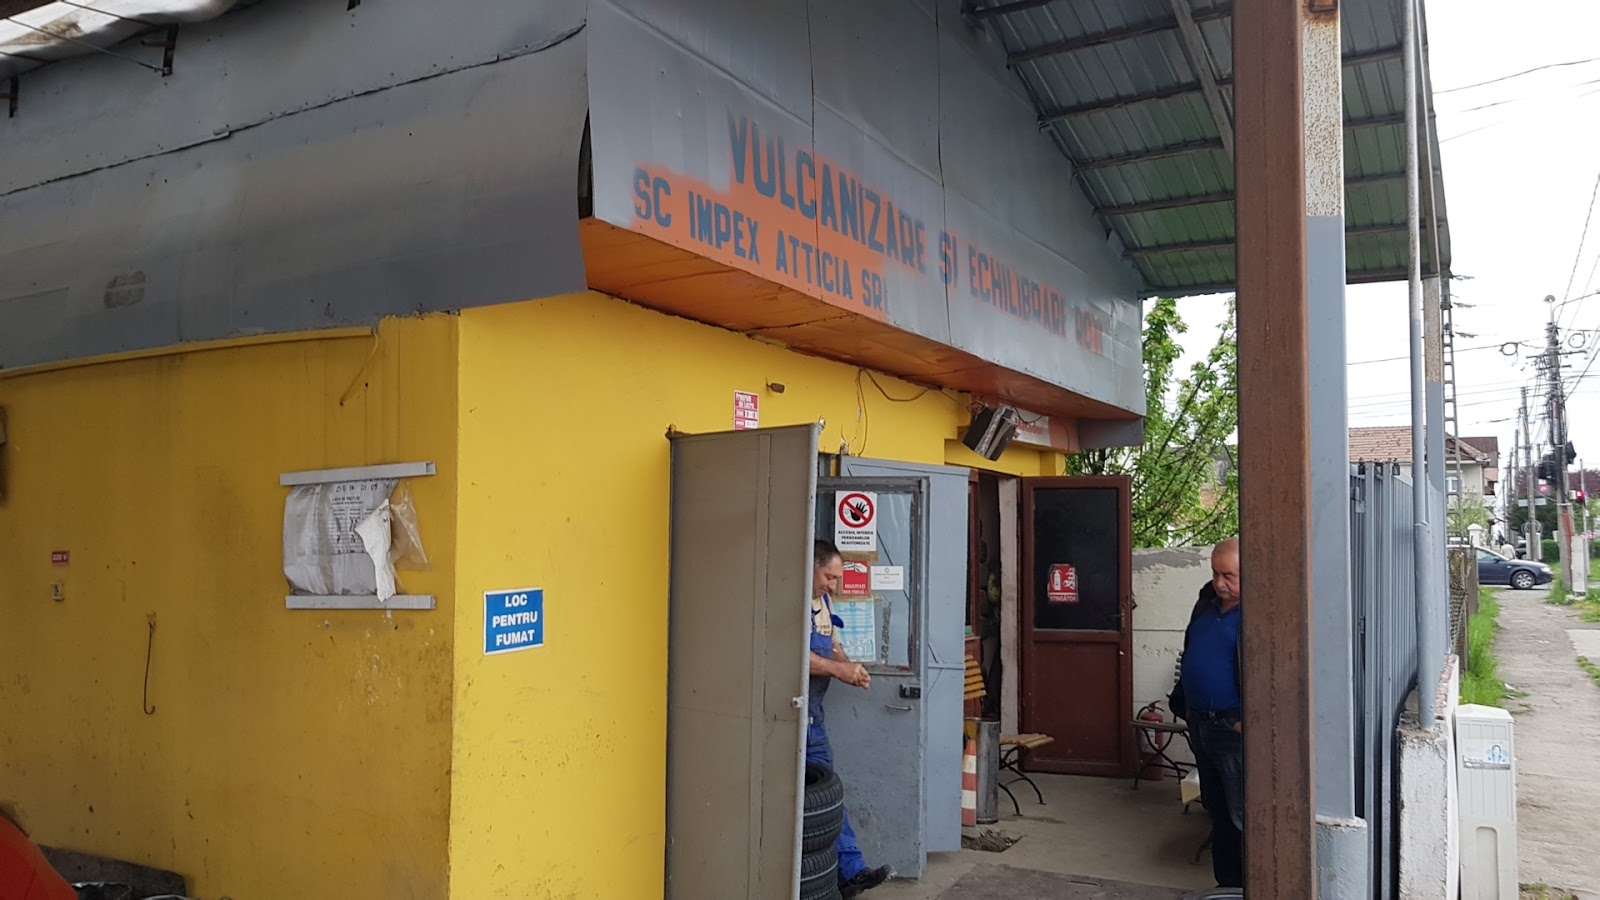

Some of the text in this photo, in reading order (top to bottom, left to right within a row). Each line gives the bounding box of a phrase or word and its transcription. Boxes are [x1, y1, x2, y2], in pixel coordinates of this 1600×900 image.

[727, 107, 927, 275] VULCANIZARE
[938, 230, 958, 288] SI
[633, 168, 671, 228] SC
[688, 190, 760, 265] IMPEX
[776, 230, 853, 300] ATTICIA
[504, 593, 528, 608] LOC
[492, 611, 538, 628] PENTRU
[496, 630, 535, 646] FUMAT
